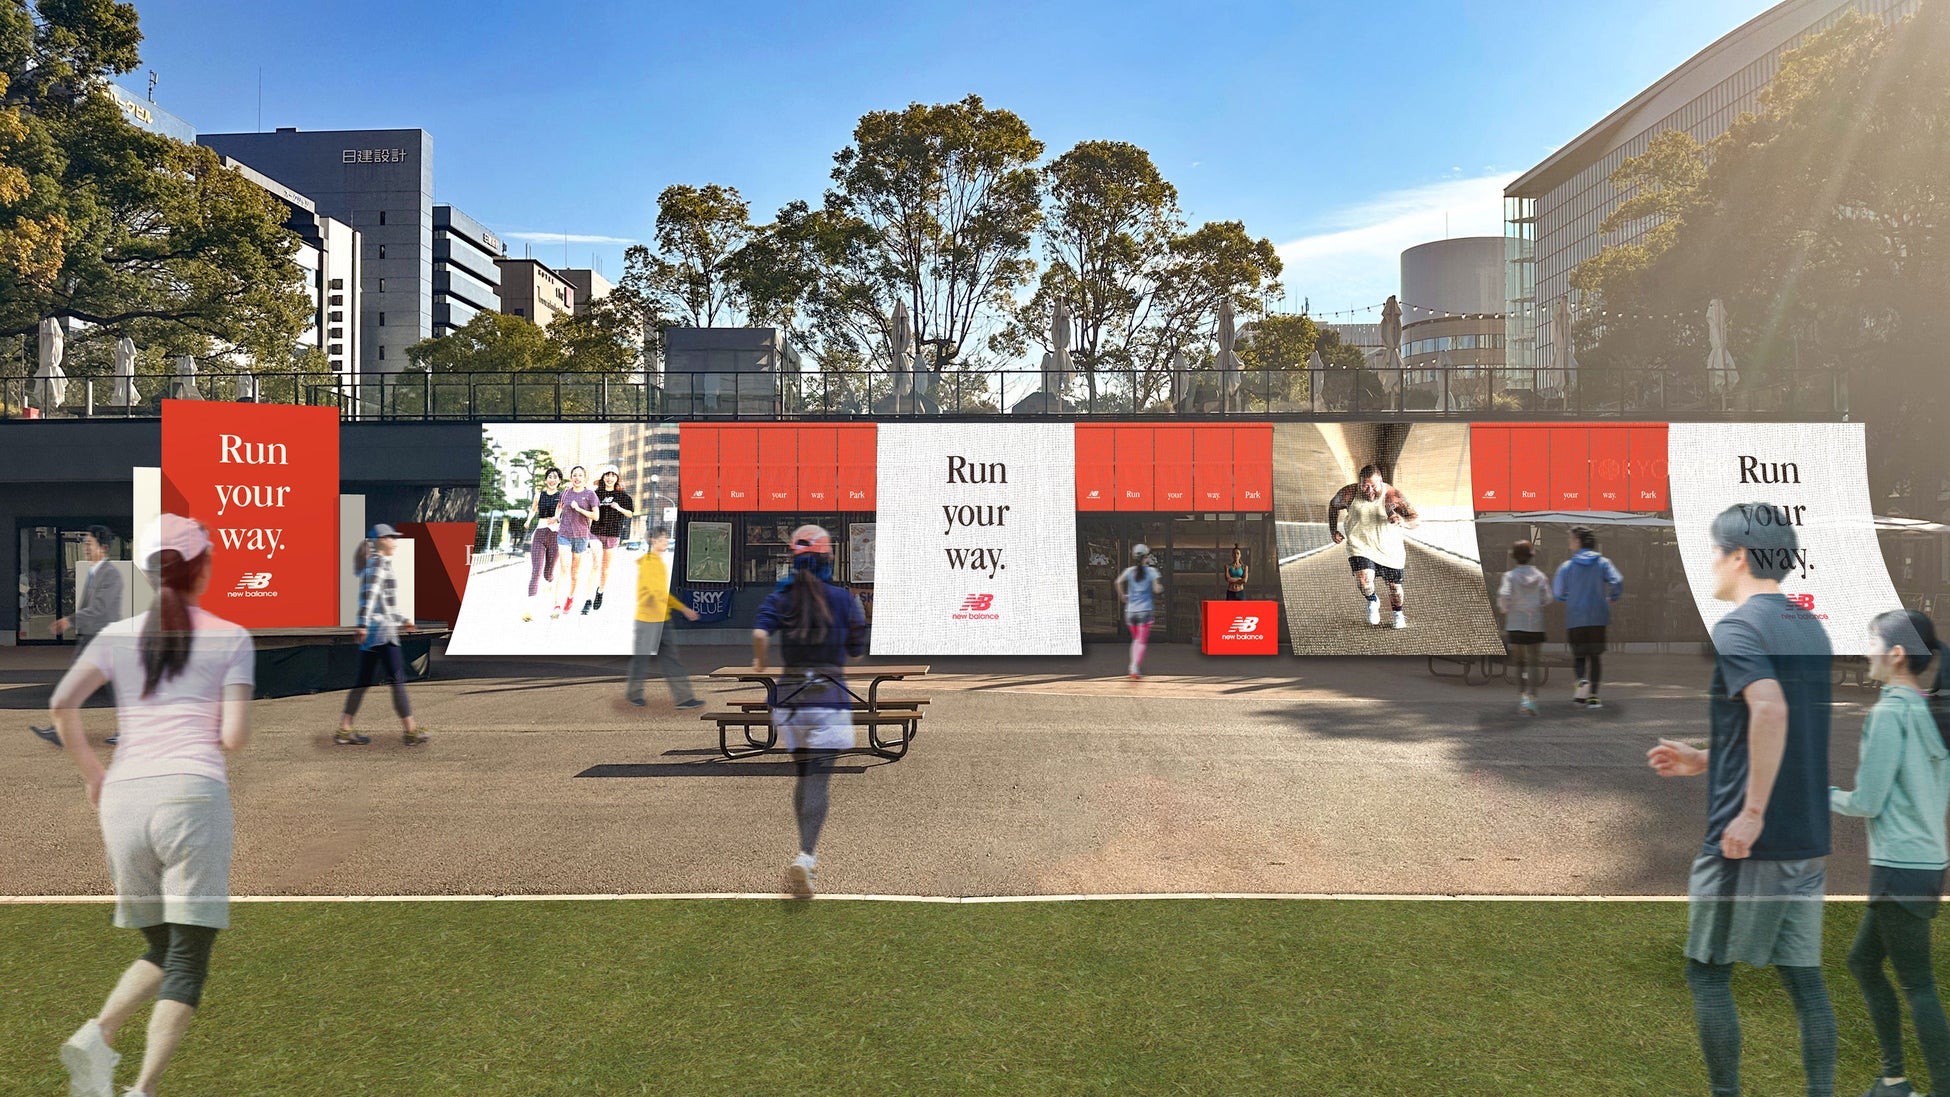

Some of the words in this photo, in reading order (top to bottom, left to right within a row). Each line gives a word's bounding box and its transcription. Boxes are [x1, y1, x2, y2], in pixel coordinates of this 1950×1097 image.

[342, 148, 407, 163] 日建設計
[219, 434, 288, 465] Run
[946, 455, 1008, 484] Run
[1738, 455, 1802, 485] Run
[215, 485, 291, 516] your
[730, 490, 744, 498] Run
[771, 492, 787, 501] your
[849, 490, 865, 499] Park
[1126, 490, 1140, 498] Run
[1168, 492, 1184, 501] your
[1246, 490, 1262, 499] Park
[1522, 490, 1536, 498] Run
[1563, 492, 1579, 501] your
[1641, 490, 1657, 499] Park
[942, 504, 1010, 536] your
[1740, 504, 1807, 536] your
[217, 528, 285, 559] way.
[944, 548, 1005, 580] way.
[1750, 547, 1815, 580] way.
[245, 589, 278, 598] balance
[692, 591, 724, 604] SKYY
[692, 602, 724, 615] BLUE
[969, 612, 1000, 620] balance
[1236, 633, 1264, 641] balance
